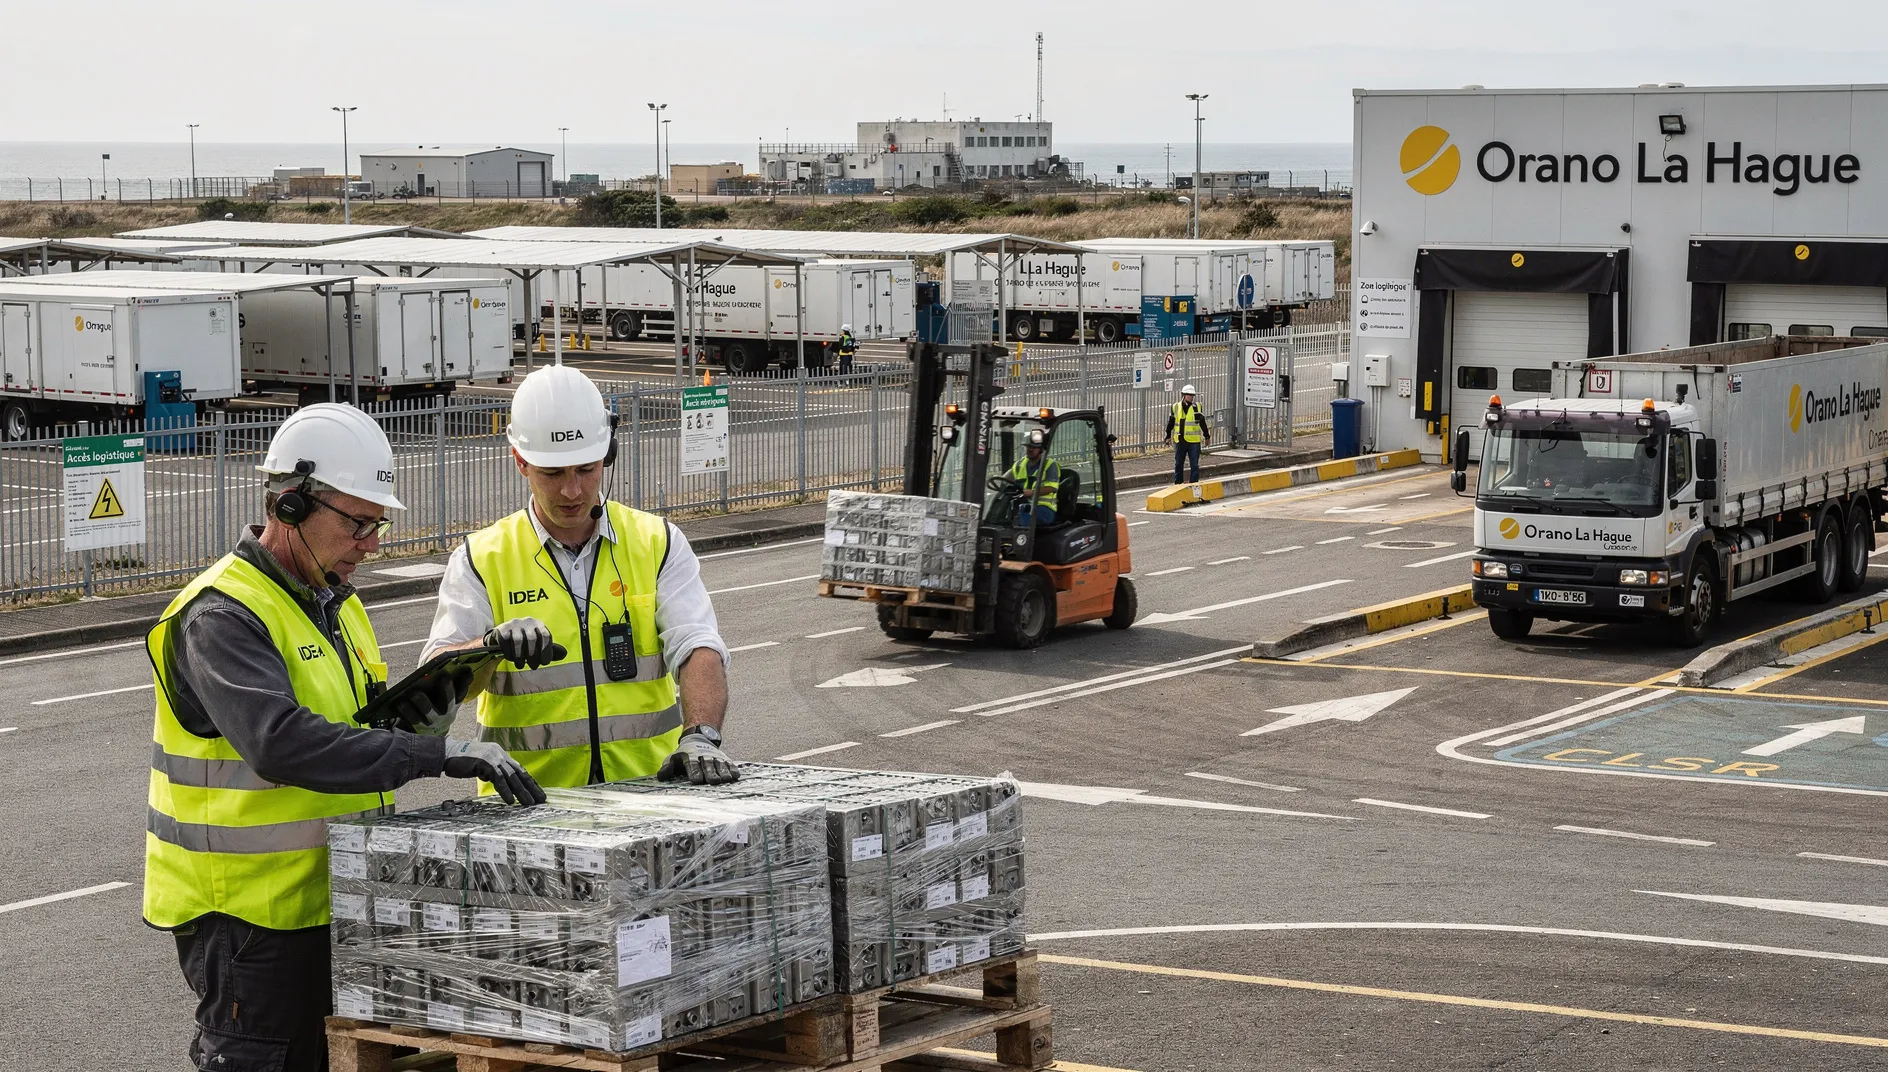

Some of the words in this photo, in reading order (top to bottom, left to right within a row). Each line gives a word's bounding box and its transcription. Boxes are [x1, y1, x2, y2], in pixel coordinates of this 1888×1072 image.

[1477, 141, 1621, 184] Orano
[1638, 142, 1689, 184] La
[1706, 142, 1860, 196] Hague
[1805, 390, 1837, 424] Orano
[1839, 384, 1850, 417] La
[1852, 381, 1881, 421] Hague
[550, 429, 584, 443] IDEA
[67, 452, 91, 463] Accès
[92, 451, 135, 463] logistique
[1524, 524, 1573, 541] Orano
[1575, 527, 1590, 541] La
[1592, 528, 1632, 546] Hague
[508, 587, 549, 605] IDEA
[298, 644, 326, 661] IDEA
[1541, 748, 1782, 777] CLSR
